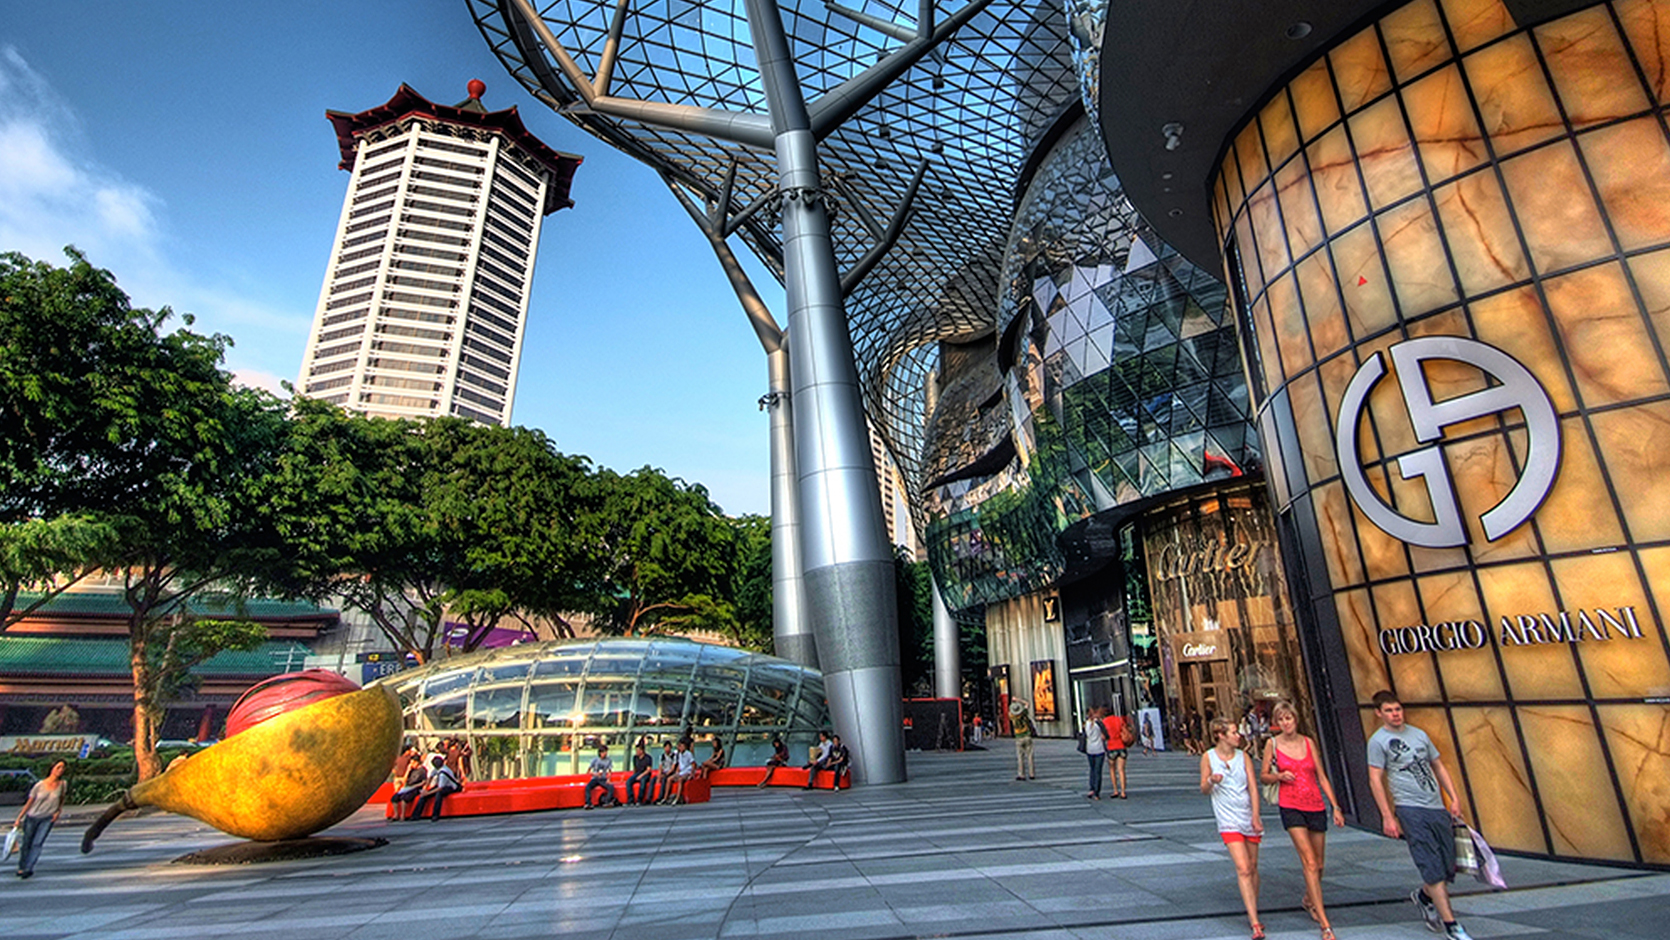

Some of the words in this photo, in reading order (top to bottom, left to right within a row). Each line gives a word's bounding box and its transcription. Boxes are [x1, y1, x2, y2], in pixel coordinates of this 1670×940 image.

[1156, 539, 1266, 581] Cartier
[1379, 619, 1487, 656] GIORGIO
[1501, 606, 1645, 646] ARMANI
[1182, 642, 1217, 658] Cartier
[8, 737, 85, 753] Marriott
